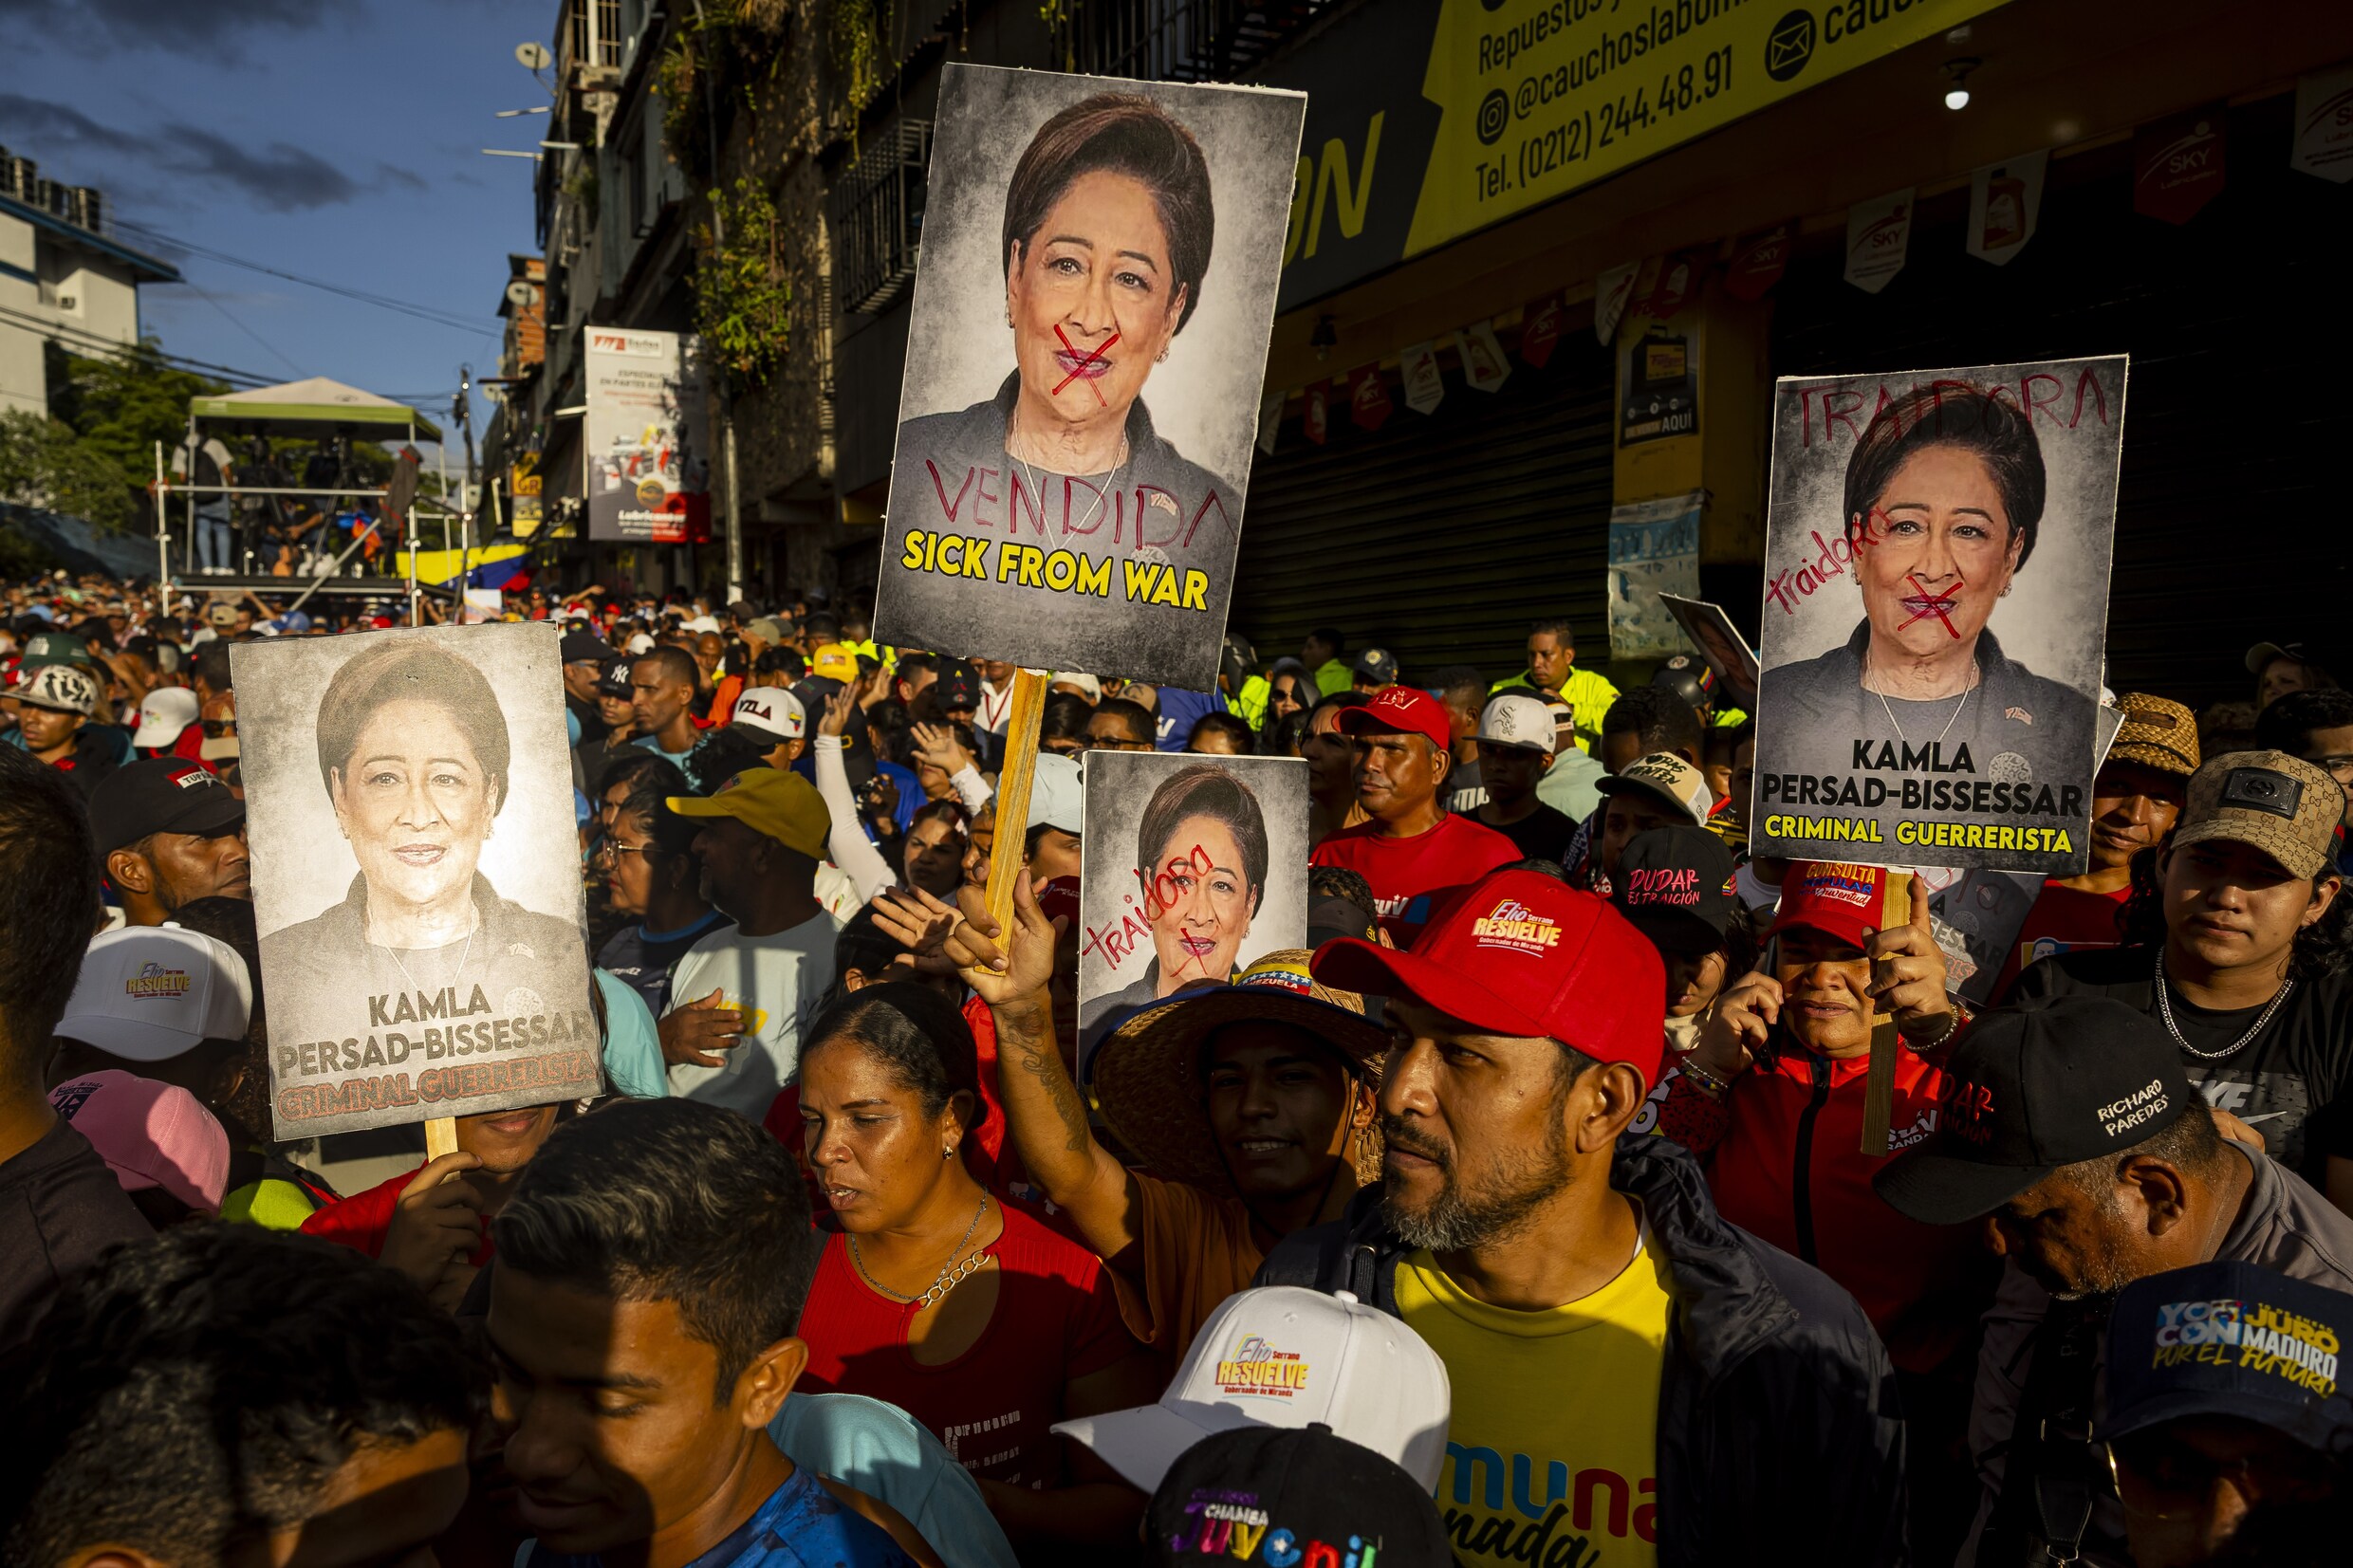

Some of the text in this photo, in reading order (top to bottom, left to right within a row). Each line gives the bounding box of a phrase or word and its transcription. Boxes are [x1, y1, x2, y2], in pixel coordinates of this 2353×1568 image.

[1475, 44, 1734, 203] Tel. (0212) 244.48.91
[2169, 145, 2212, 175] SKY
[1871, 228, 1906, 249] SKY
[1780, 365, 2107, 448] TRAIDORA
[925, 458, 1237, 550] VENDIDA
[900, 528, 1211, 612] SICK FROM WAR
[1851, 739, 1976, 774] KAMLA
[1760, 773, 2084, 818] PERSAD-BISSESSAR
[1763, 813, 2075, 855] CRIMINAL GUERRERISTA
[1629, 868, 1700, 892] DUDAR
[1806, 862, 1876, 885] CONSULTA
[1492, 900, 1555, 925] Elio Serrano
[1627, 891, 1640, 905] ES
[1471, 917, 1563, 948] RESUELVE
[1478, 936, 1512, 947] Gobernador
[1520, 942, 1545, 952] Miranda
[126, 976, 191, 995] RESUELVE
[1247, 978, 1298, 989] NEZUELA
[368, 983, 493, 1027] KAMLA
[276, 1010, 596, 1079] PERSAD-BISSESSAR
[277, 1048, 599, 1121] CRIMINAL GUERRERISTA
[2104, 1094, 2171, 1137] PAREDES
[2159, 1301, 2212, 1326] YO
[2243, 1306, 2341, 1356] JURO
[1233, 1336, 1300, 1364] Elio Serrano
[2155, 1320, 2339, 1381] CON MADURO
[1215, 1360, 1309, 1390] RESUELVE
[2151, 1342, 2337, 1400] POR EL FUTURO
[1224, 1386, 1259, 1394] Gobernador
[1269, 1388, 1293, 1397] Miranda
[1434, 1440, 1658, 1544] muna
[1204, 1503, 1269, 1527] CHAMBA
